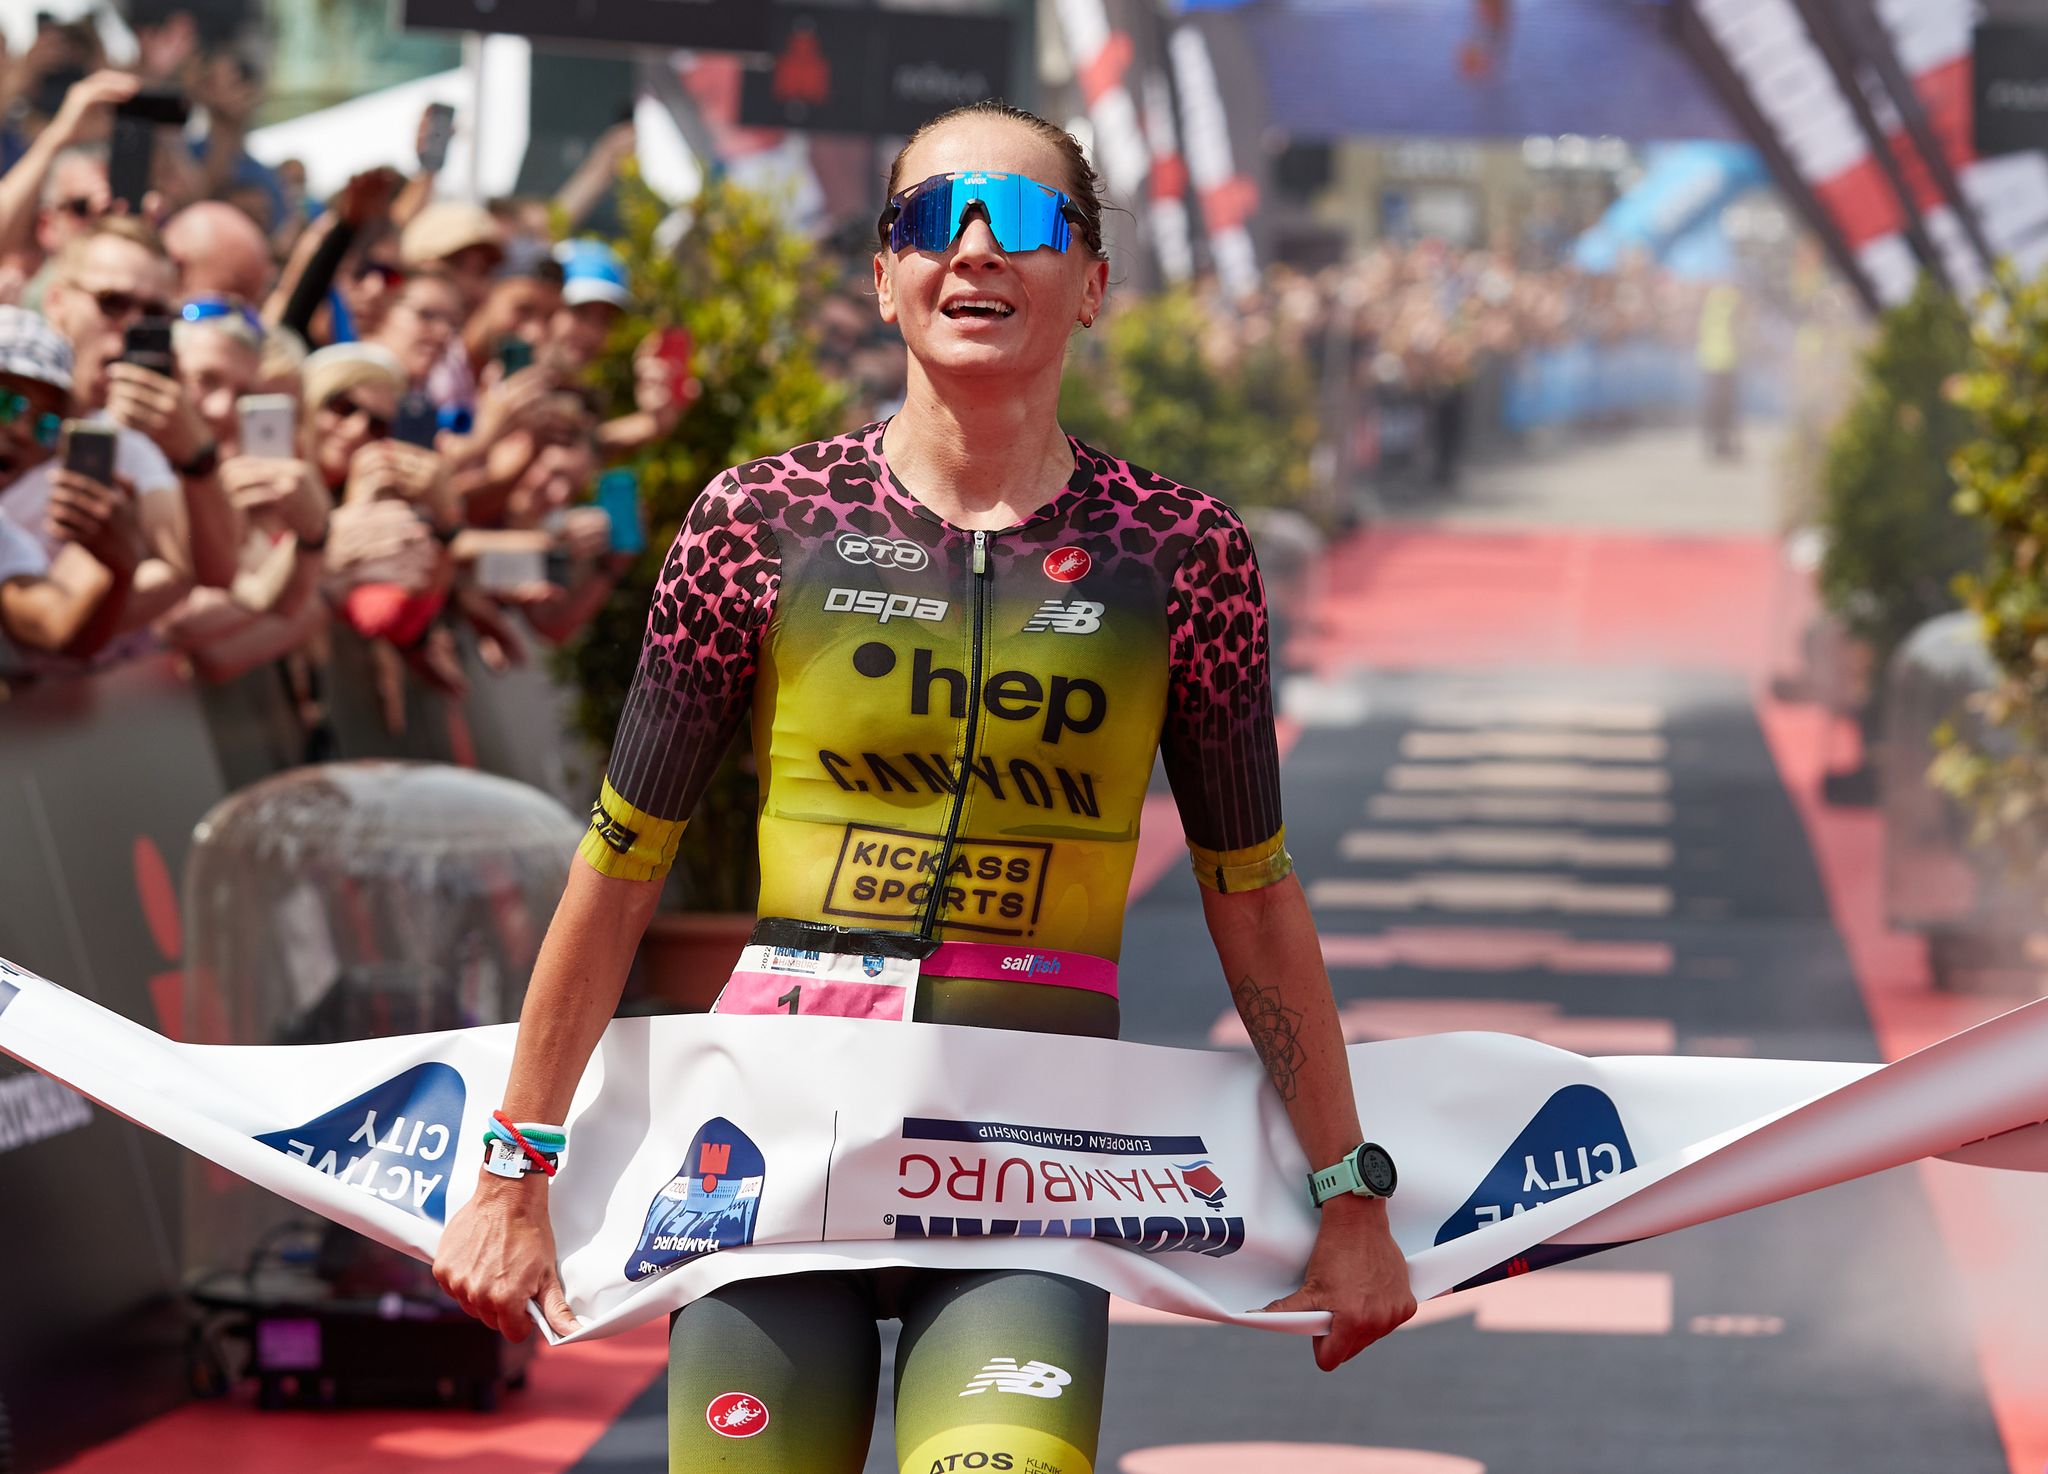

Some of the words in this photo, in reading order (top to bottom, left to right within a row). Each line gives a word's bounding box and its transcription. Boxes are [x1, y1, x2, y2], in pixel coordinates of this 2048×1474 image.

[843, 540, 922, 564] PTO
[823, 588, 949, 624] ospa
[1022, 600, 1106, 635] NB
[911, 648, 1107, 744] hep
[819, 750, 1101, 818] CANYON
[853, 841, 1030, 882] KICKASS
[853, 876, 1025, 918] SPORTS
[1001, 954, 1061, 977] sailfish
[349, 1109, 450, 1161] CITY
[979, 1126, 1083, 1148] CHAMPIONSHIP
[1090, 1135, 1152, 1152] EUROPEAN
[898, 1154, 1190, 1204] HAMBURG
[1523, 1143, 1622, 1191] CITY
[652, 1235, 720, 1252] HAMBURG
[959, 1357, 1073, 1399] NB
[930, 1452, 1014, 1474] ATOS
